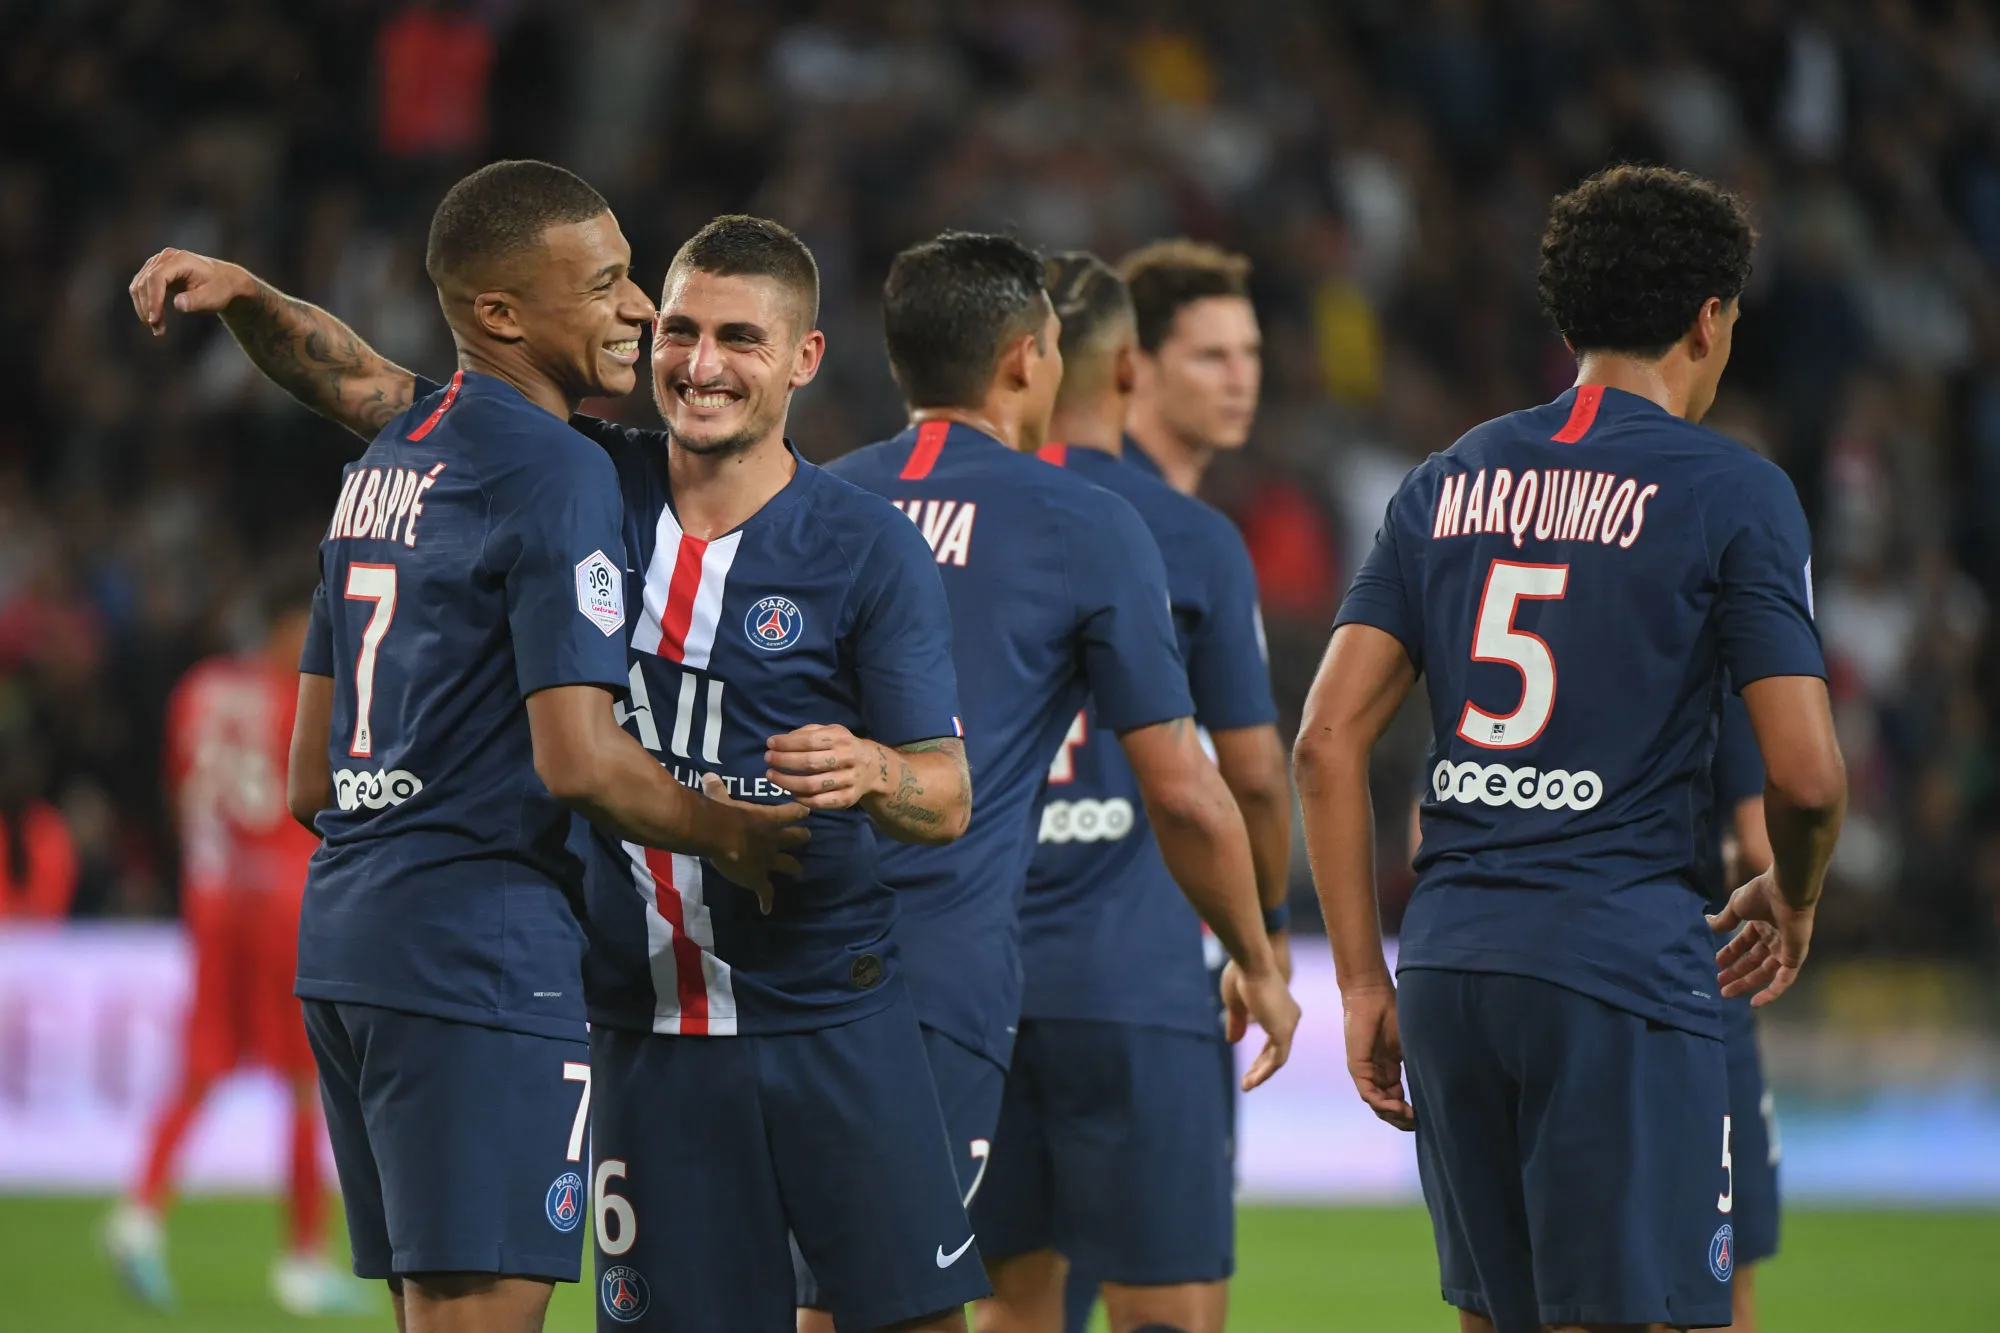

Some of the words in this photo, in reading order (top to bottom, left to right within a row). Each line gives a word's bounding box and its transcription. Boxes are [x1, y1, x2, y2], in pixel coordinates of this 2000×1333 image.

[329, 461, 447, 548] MBAPPÉ
[1432, 468, 1659, 549] MARQUINHOS
[590, 597, 612, 608] LIGUE
[759, 599, 796, 616] PARIS
[344, 561, 397, 757] 7
[1456, 558, 1570, 750] 5
[563, 1061, 591, 1162] 7
[556, 1175, 580, 1190] PARIS
[594, 1158, 637, 1256] 6
[606, 1268, 637, 1283] PARIS
